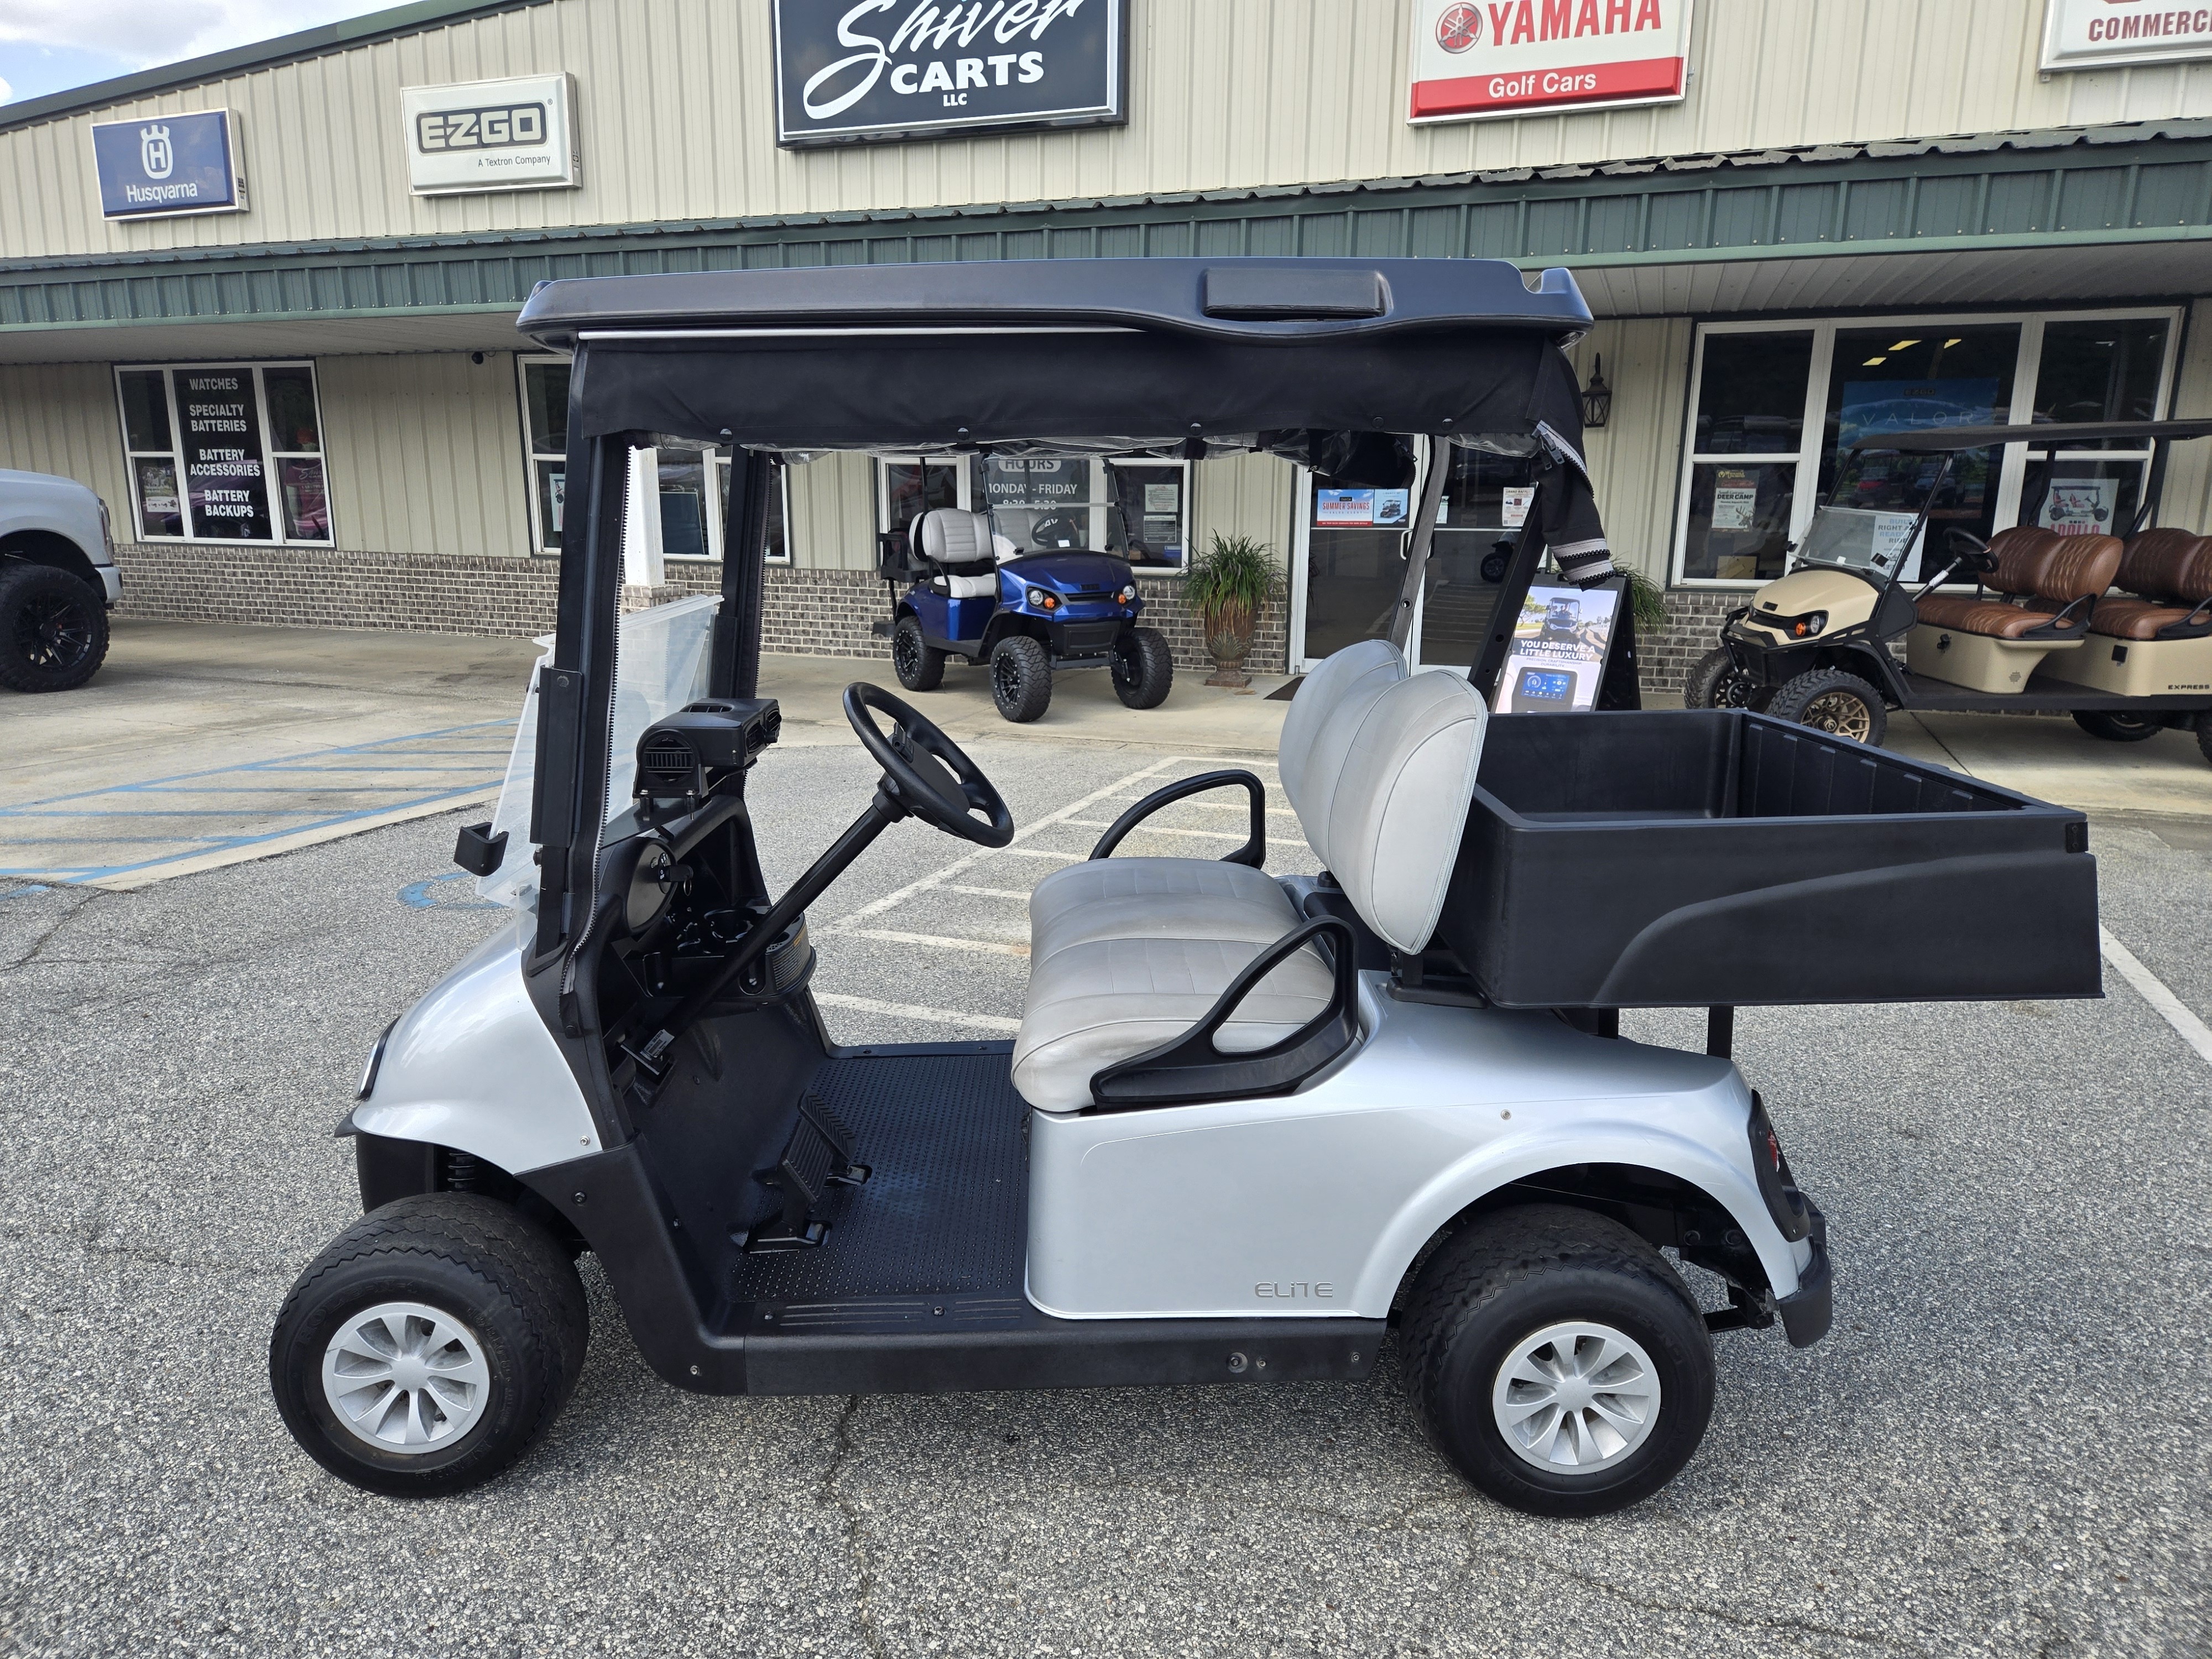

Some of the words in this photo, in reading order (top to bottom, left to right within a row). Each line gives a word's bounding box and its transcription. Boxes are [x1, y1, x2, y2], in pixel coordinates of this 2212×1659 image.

[1488, 0, 1662, 46] YAMAHA
[803, 0, 1084, 119] Shiver
[890, 51, 1045, 95] CARTS
[1489, 75, 1536, 98] Golf
[1542, 72, 1597, 93] Cars
[942, 93, 968, 107] LLC
[420, 107, 542, 149] EZGO
[486, 158, 513, 166] Textron
[515, 155, 551, 165] Company
[126, 182, 198, 204] Husqvarna
[189, 377, 238, 390] WATCHES
[189, 404, 244, 417] SPECIALTY
[1863, 411, 1974, 426] VALOR
[191, 420, 247, 432] BATTERIES
[199, 448, 244, 461] BATTERY
[190, 464, 260, 477] ACCESSORIES
[983, 483, 1026, 494] ONDA
[1039, 484, 1078, 494] FRIDAY
[205, 490, 249, 502] BATTERY
[205, 505, 254, 517] BACKUPS
[1521, 640, 1541, 648] YOU
[1541, 641, 1587, 653] DESERVE
[1520, 648, 1552, 657] LITTLE
[1552, 651, 1593, 661] LUXURY
